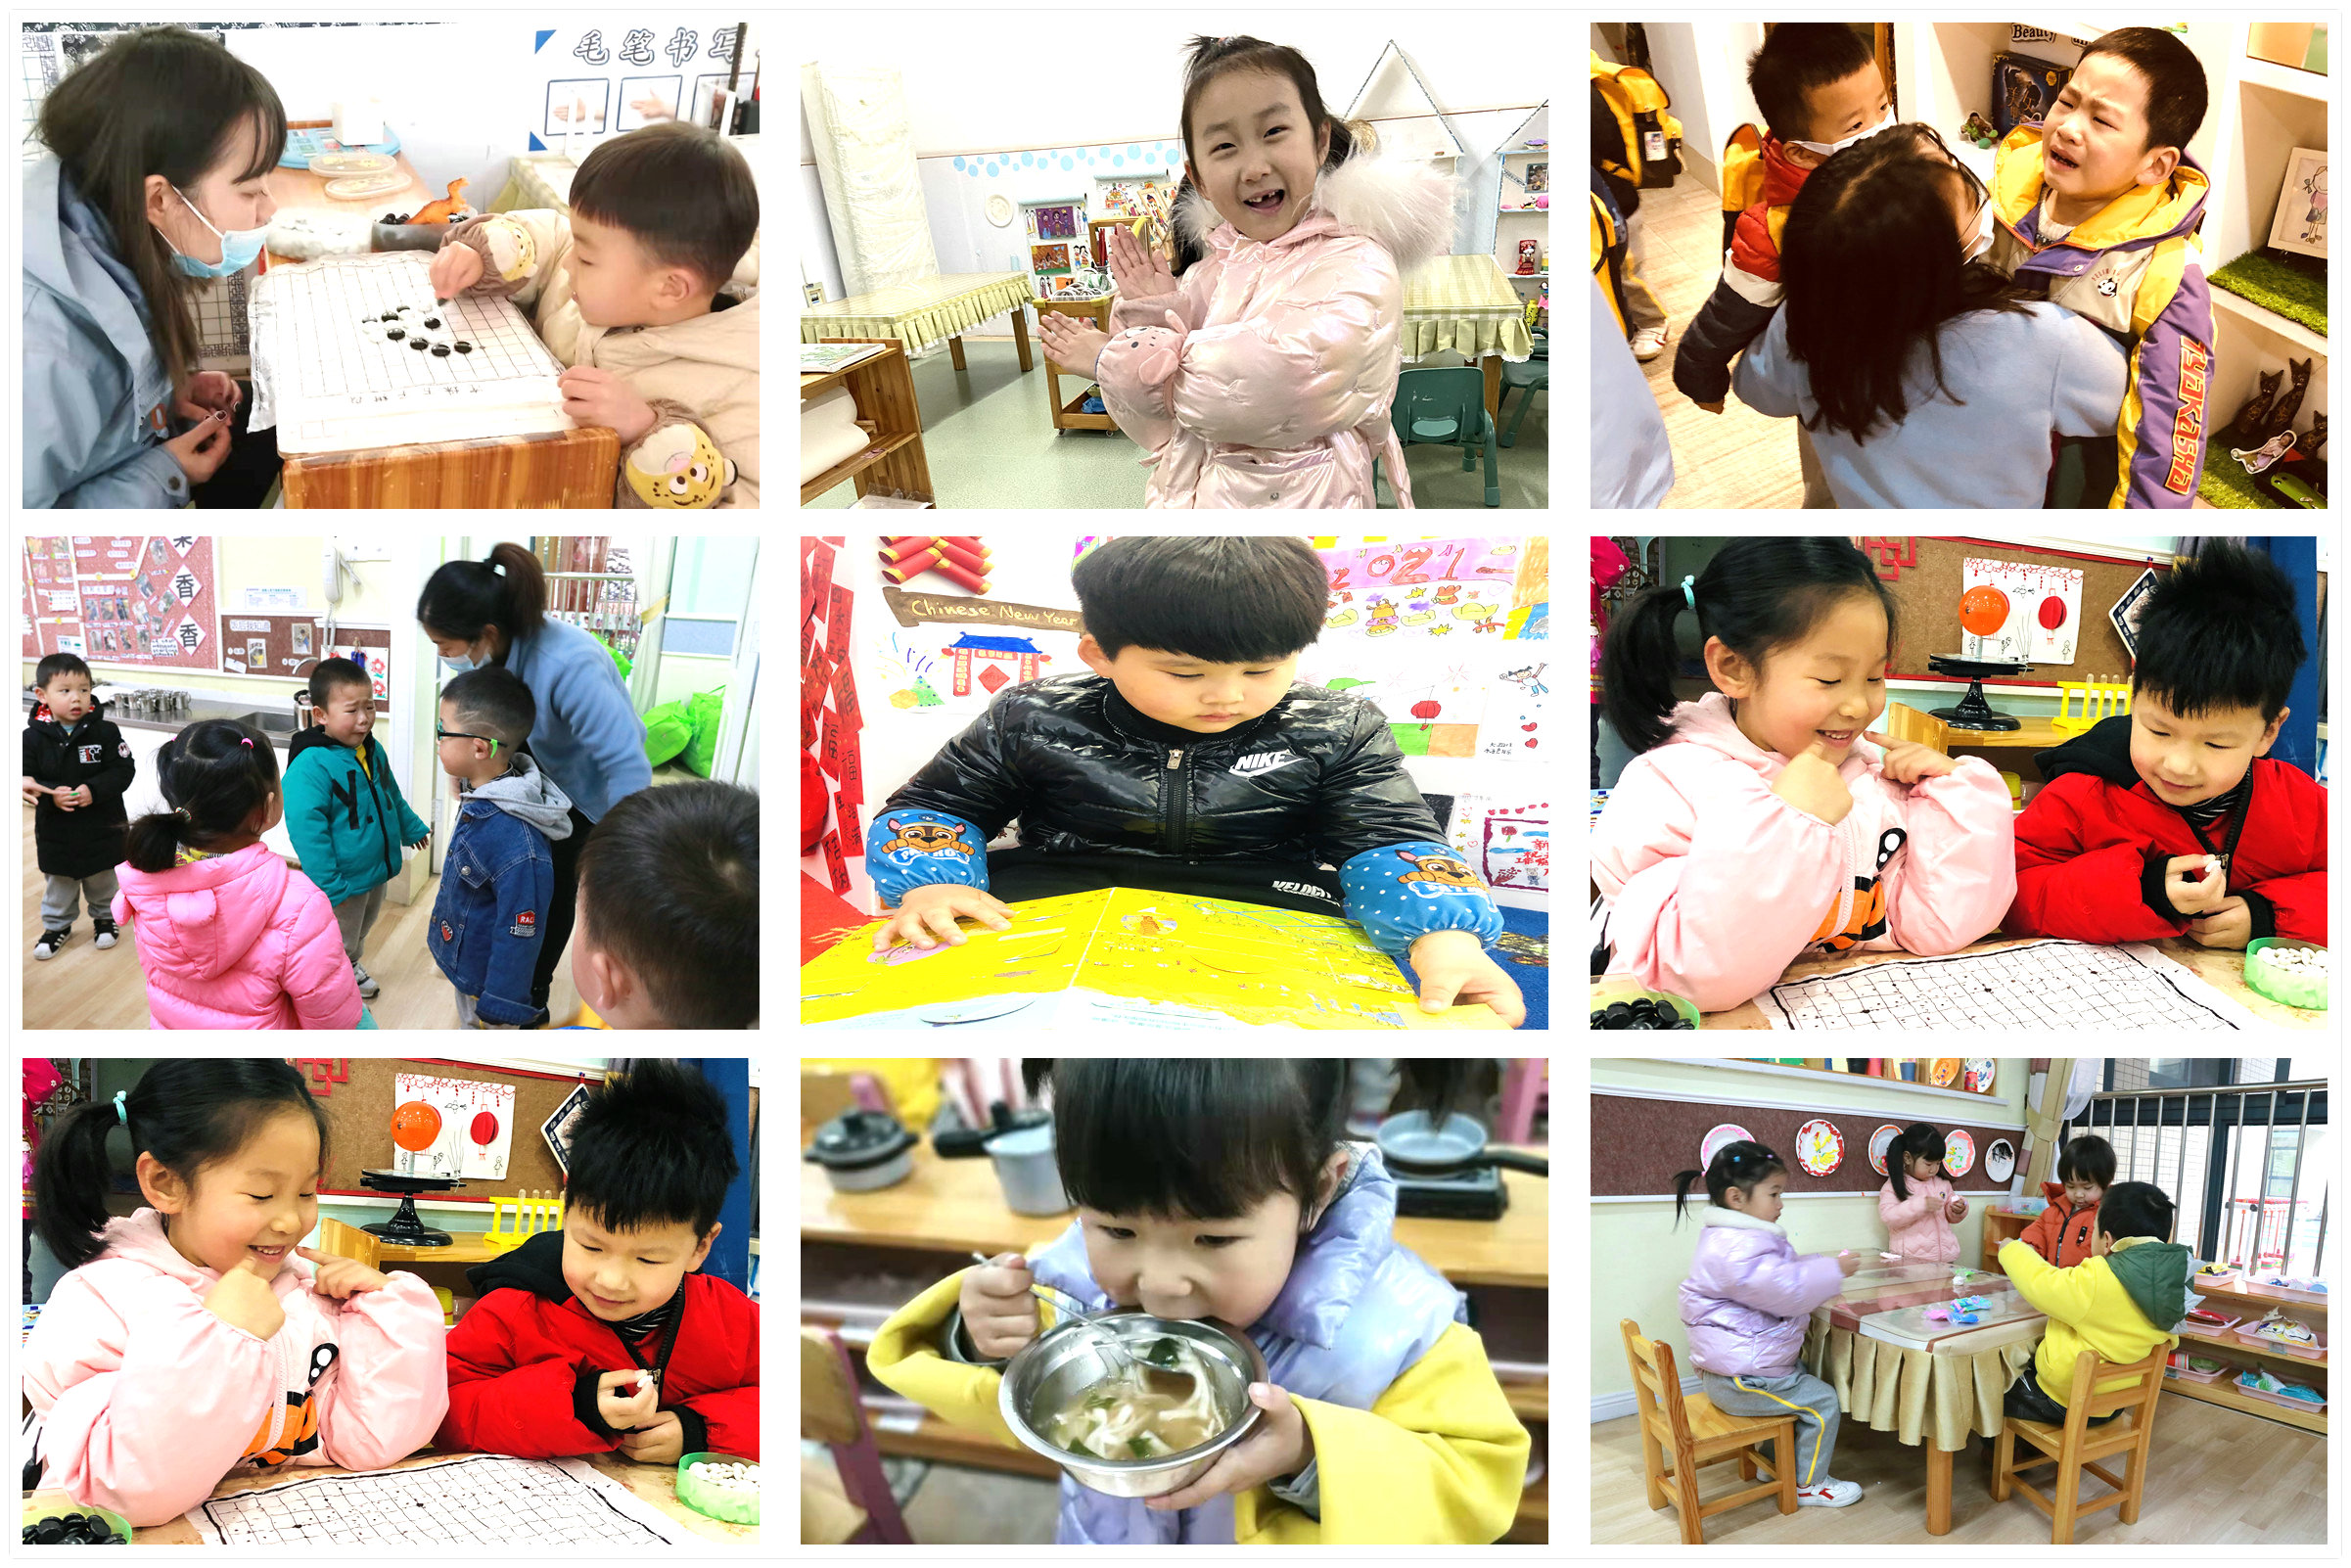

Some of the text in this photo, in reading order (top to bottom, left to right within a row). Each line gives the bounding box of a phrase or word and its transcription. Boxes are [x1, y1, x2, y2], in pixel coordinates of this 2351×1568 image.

[573, 26, 737, 68] 毛笔书写
[1329, 546, 1465, 591] 2021
[911, 599, 1078, 626] Chinese New Year
[1234, 750, 1290, 770] NIKE
